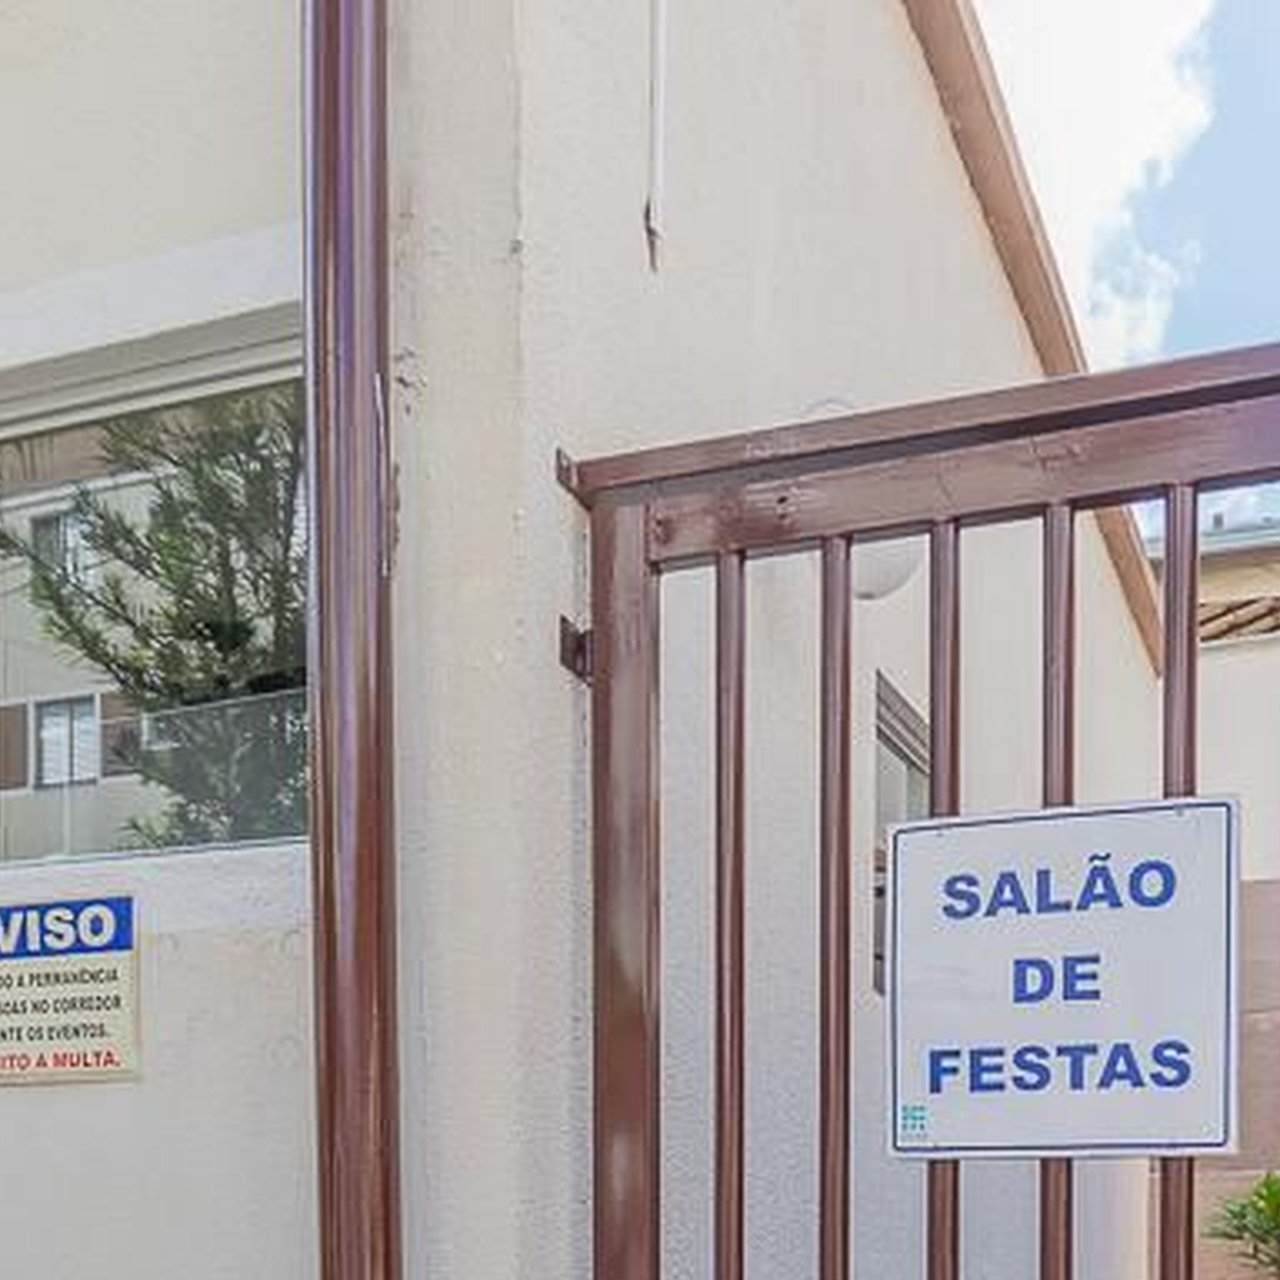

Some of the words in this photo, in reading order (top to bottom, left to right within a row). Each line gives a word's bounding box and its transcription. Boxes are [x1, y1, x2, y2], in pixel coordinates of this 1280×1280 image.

[941, 853, 1178, 920] SALÃO
[29, 968, 119, 988] PERMANÊNCIA
[1011, 954, 1102, 1004] DE
[30, 999, 51, 1014] NO
[53, 995, 121, 1014] CORREDOR
[26, 1026, 44, 1041] OS
[35, 1053, 48, 1068] A
[52, 1050, 121, 1069] MULTA.
[929, 1041, 1192, 1095] FESTAS
